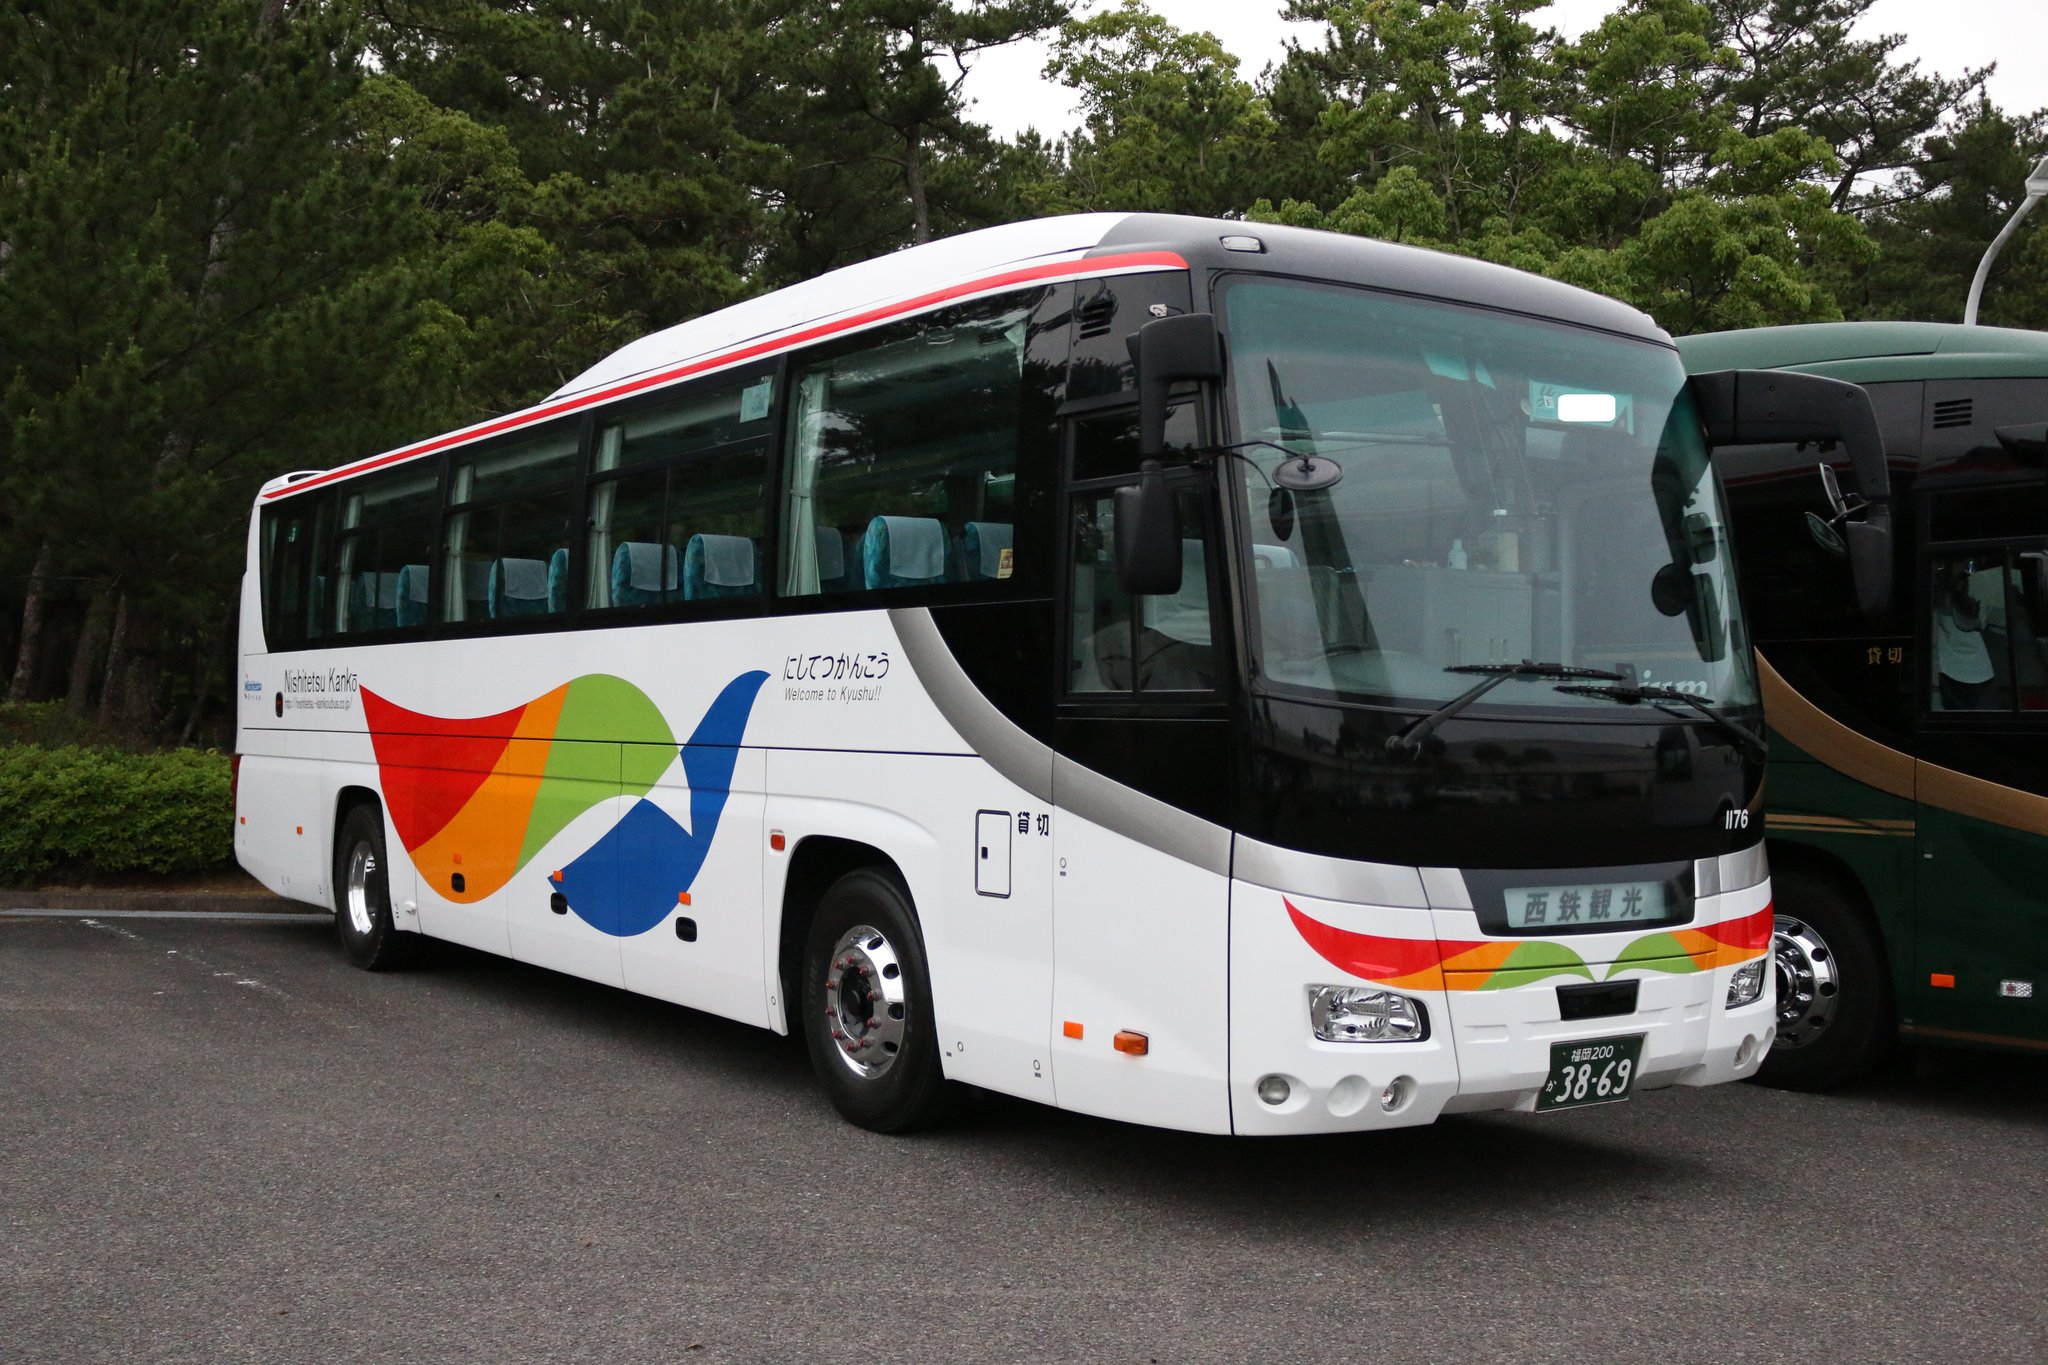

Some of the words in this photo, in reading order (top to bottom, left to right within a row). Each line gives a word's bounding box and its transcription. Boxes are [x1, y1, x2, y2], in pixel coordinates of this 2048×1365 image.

[782, 652, 890, 681] にしてつかんこう
[1866, 646, 1903, 665] 貸切
[284, 669, 326, 693] Nishitetsu
[784, 687, 824, 701] Welcome
[827, 688, 837, 701] to
[840, 685, 882, 704] Kyushu!!
[1017, 811, 1050, 837] 貸切
[1725, 809, 1749, 830] 1176
[1555, 1058, 1632, 1103] 38-69
